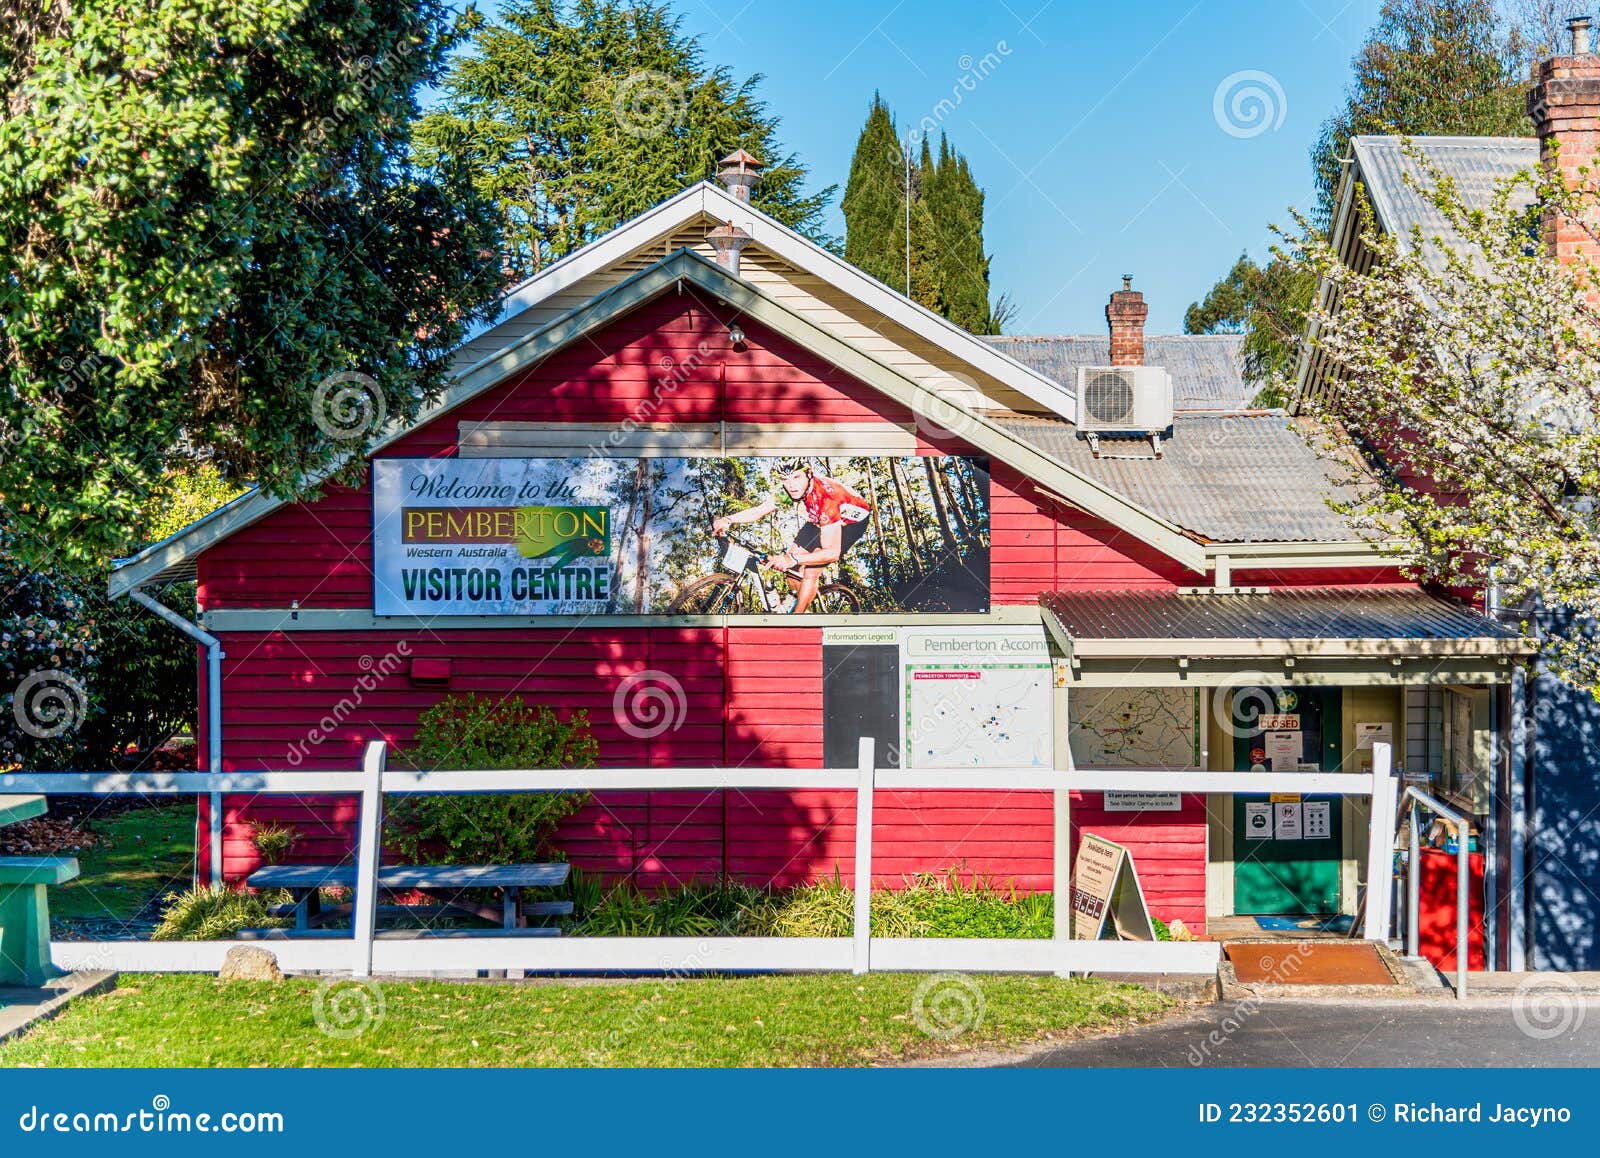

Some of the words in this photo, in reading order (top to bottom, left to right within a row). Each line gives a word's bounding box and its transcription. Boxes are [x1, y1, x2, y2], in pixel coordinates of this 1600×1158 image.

[410, 474, 511, 499] Welcome
[518, 480, 541, 499] to
[545, 476, 582, 499] the
[406, 511, 605, 543] PEMBERTON
[407, 547, 452, 558] Western
[458, 547, 507, 558] Australia
[402, 568, 502, 601] VISITOR
[511, 567, 609, 601] CENTRE
[827, 631, 866, 641] Information
[868, 631, 894, 642] Legend
[924, 638, 996, 652] Pemberton
[1260, 719, 1299, 728] CLOSED
